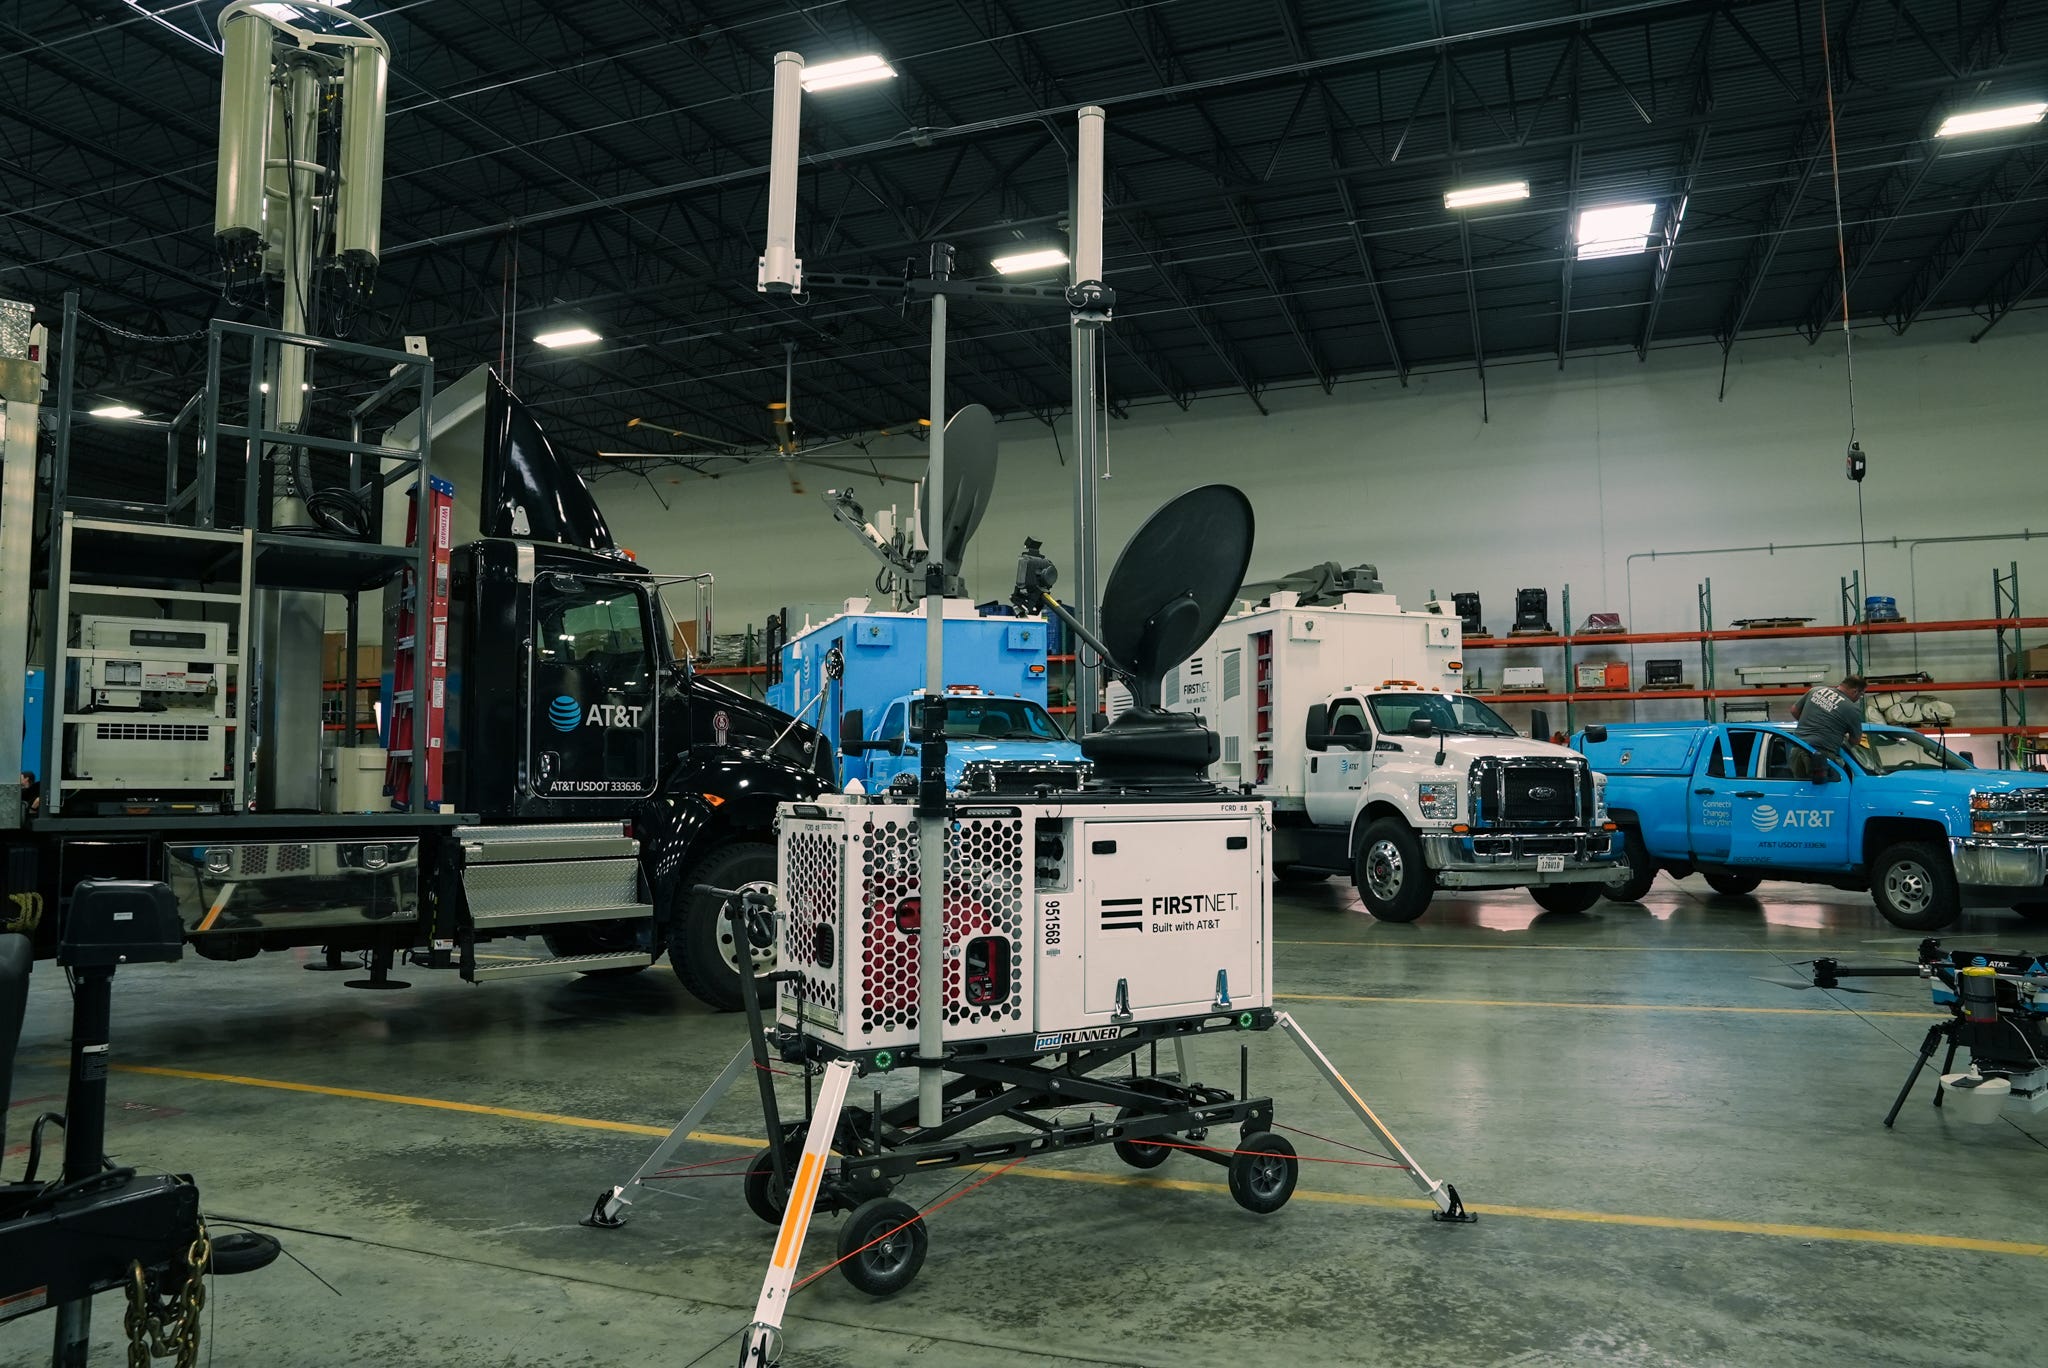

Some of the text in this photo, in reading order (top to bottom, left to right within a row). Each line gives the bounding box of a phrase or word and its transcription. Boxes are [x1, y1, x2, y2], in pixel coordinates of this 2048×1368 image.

[1817, 688, 1845, 704] AT&T
[586, 704, 643, 728] AT&T
[550, 781, 641, 791] AT&T USDOT 333636
[1702, 808, 1730, 819] Changes
[1783, 810, 1834, 828] AT&T
[1152, 892, 1237, 915] FIRSTNET
[1045, 900, 1061, 945] 951568
[1152, 919, 1220, 933] Built with AT&T
[1036, 1027, 1118, 1050] podRUNNER
